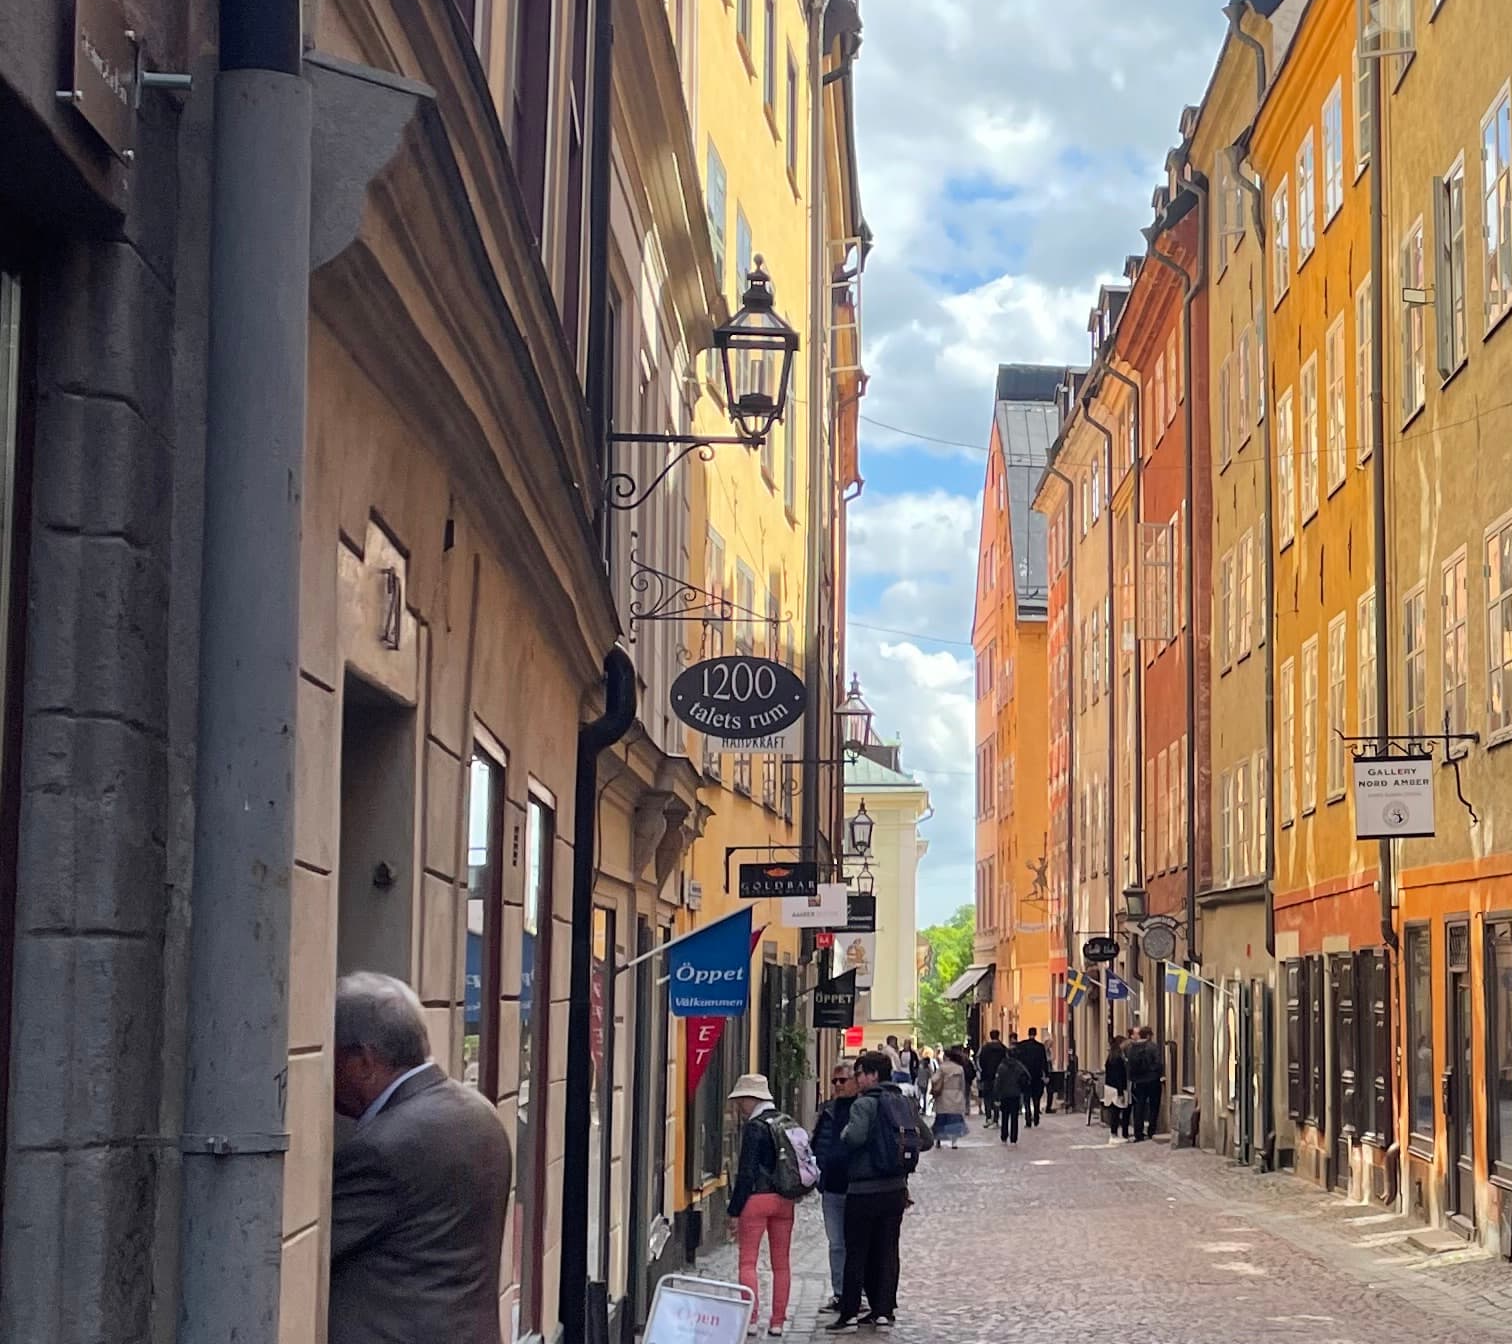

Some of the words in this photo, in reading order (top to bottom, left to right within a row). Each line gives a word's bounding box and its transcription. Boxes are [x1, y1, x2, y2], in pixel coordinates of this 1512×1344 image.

[702, 662, 776, 702] 1200
[689, 702, 742, 729] talets
[750, 703, 789, 729] rum
[1368, 768, 1416, 776] GALLERY
[676, 962, 744, 984] Öppet
[815, 992, 852, 1004] ÖPPET
